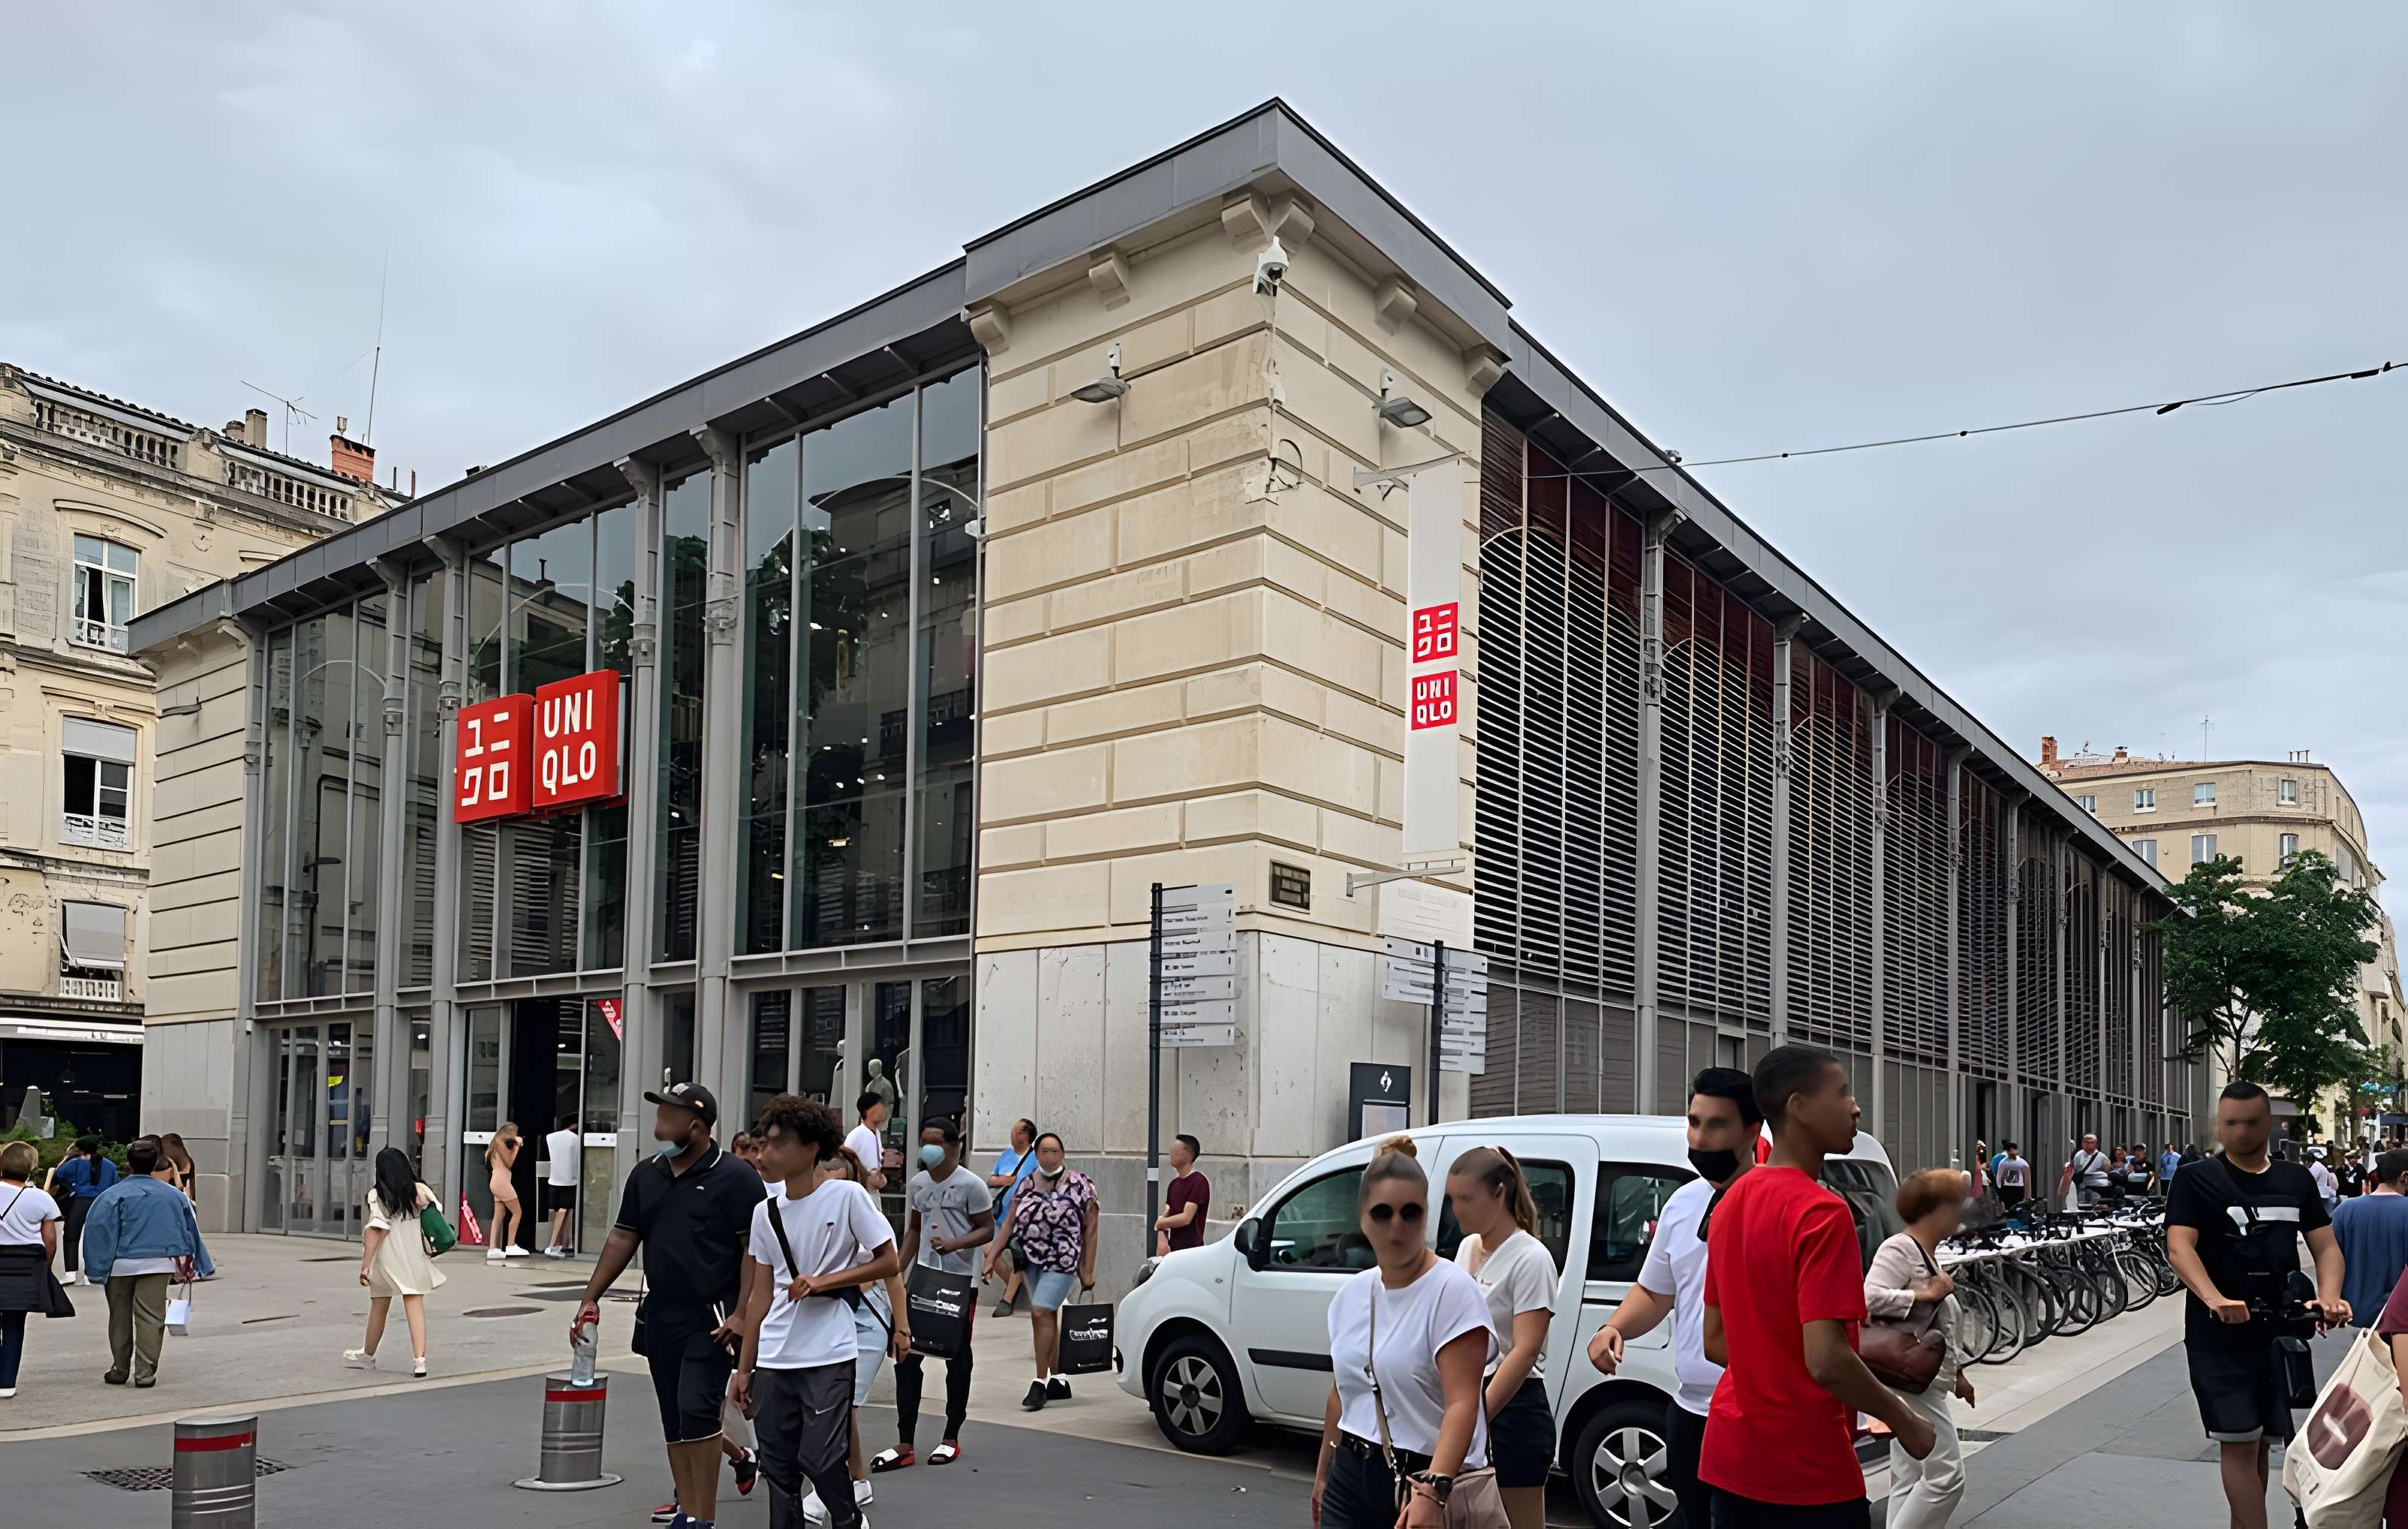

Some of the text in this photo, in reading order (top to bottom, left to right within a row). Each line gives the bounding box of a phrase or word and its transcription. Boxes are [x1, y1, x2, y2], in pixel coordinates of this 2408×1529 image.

[1418, 609, 1452, 634] ユニ
[1417, 634, 1452, 657] クロ
[1417, 677, 1449, 701] UNI
[543, 689, 593, 738] UNI
[1416, 701, 1452, 724] QLO
[465, 711, 510, 758] ユニ
[461, 761, 509, 806] クロ
[542, 740, 596, 795] QLO
